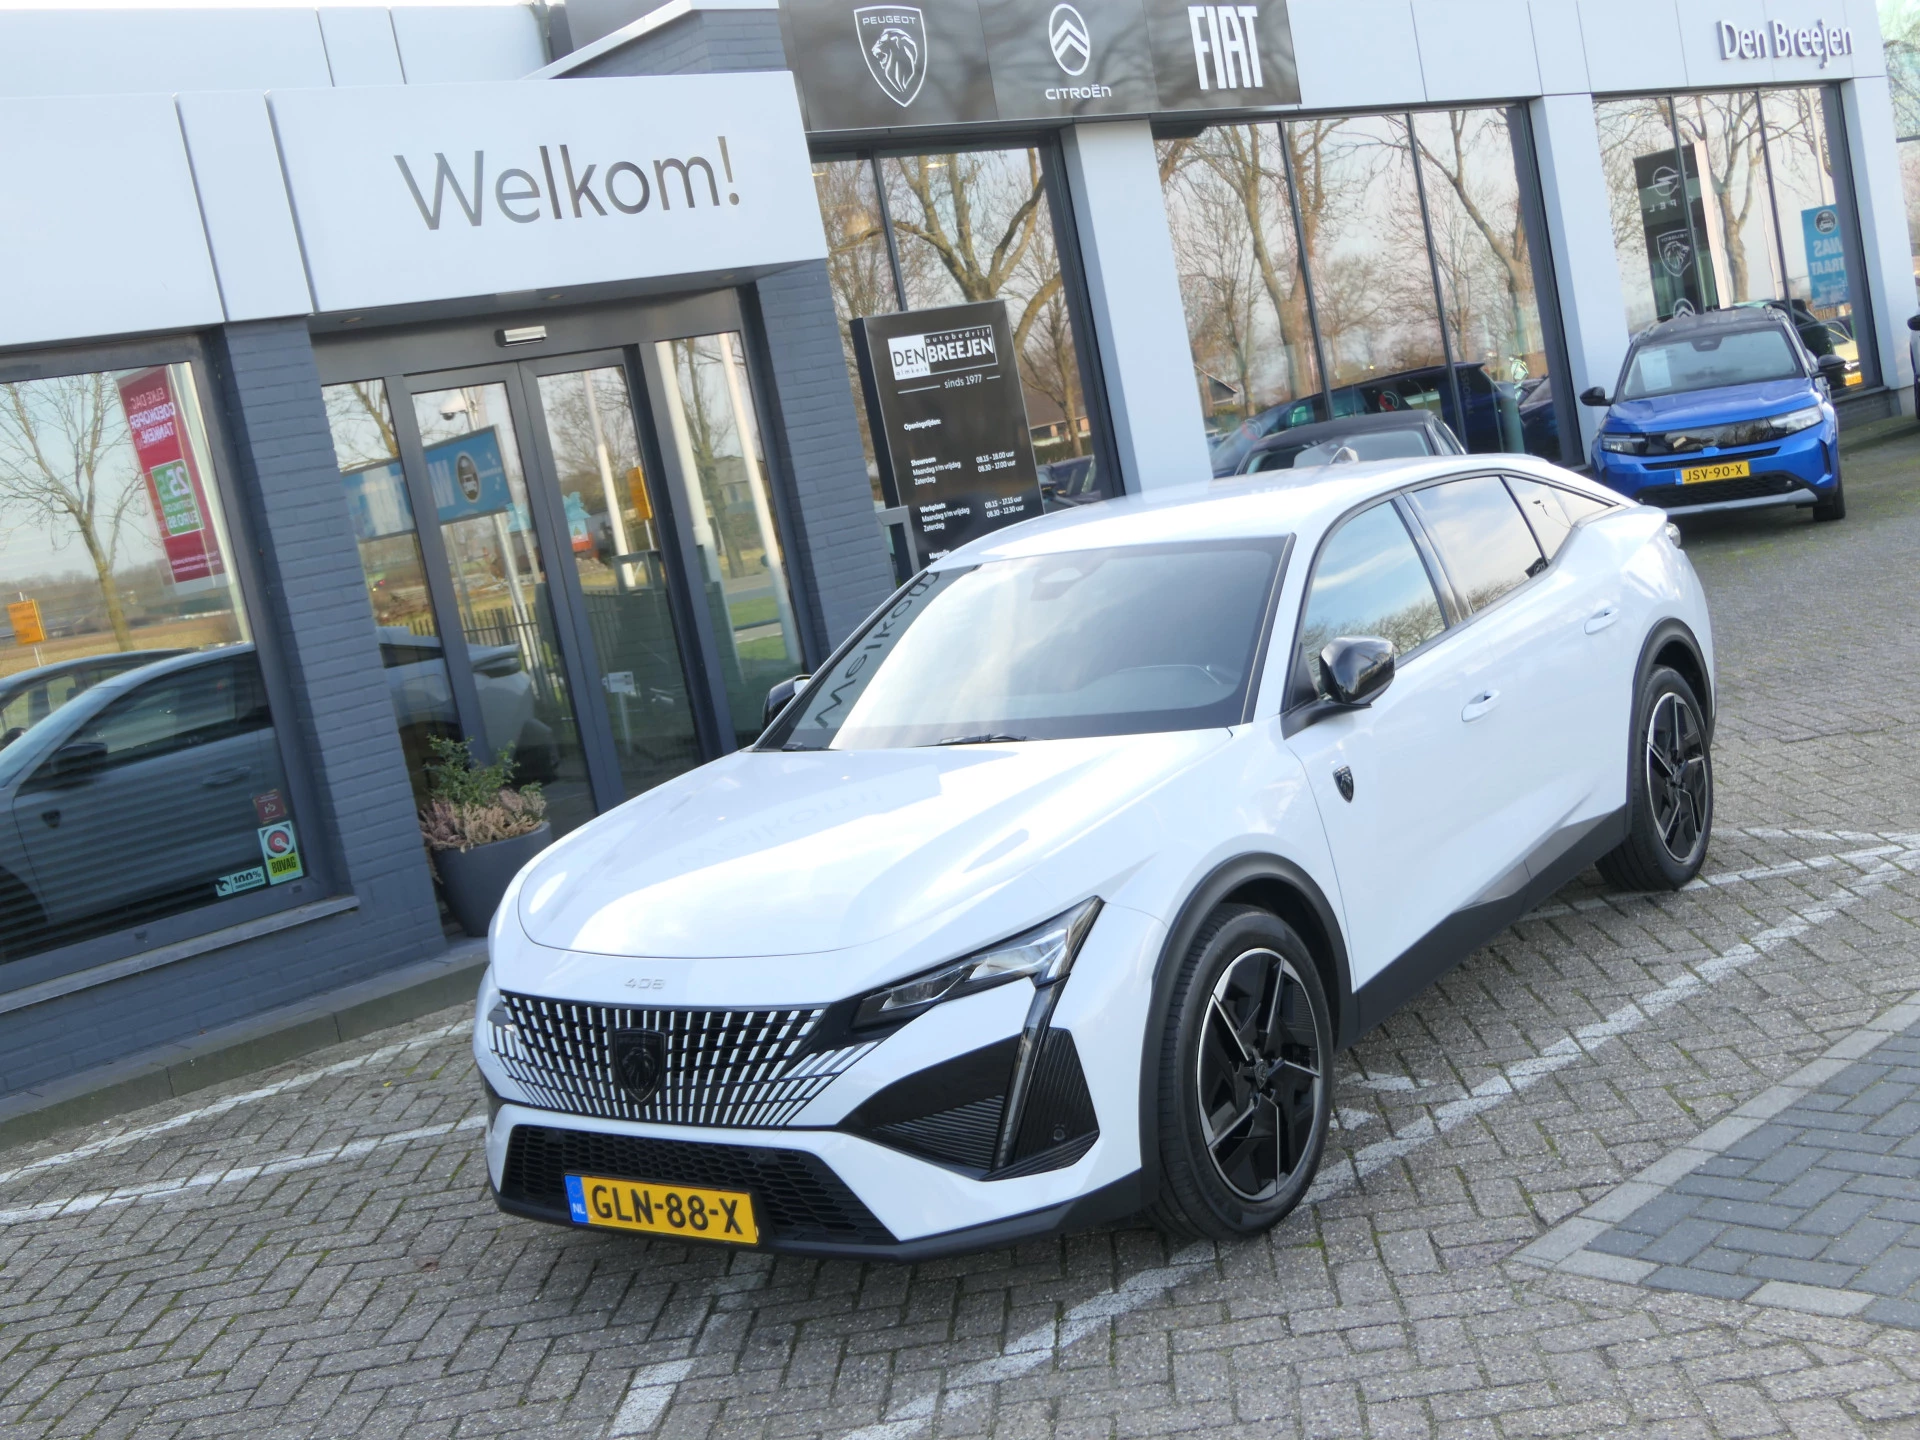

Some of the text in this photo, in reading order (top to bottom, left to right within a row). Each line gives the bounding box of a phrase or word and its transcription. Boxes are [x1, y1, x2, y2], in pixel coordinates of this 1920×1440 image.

[862, 14, 917, 26] PEUGEOT
[1187, 4, 1264, 91] FIAT
[1715, 18, 1853, 69] Den Breejen
[1045, 83, 1112, 101] CITROËN
[394, 135, 741, 231] Welkom!
[925, 328, 990, 344] autobedrijf
[892, 337, 995, 368] DEN BREEJEN
[944, 374, 983, 389] sinds 1977
[910, 456, 937, 467] Showroom
[912, 466, 935, 476] Maandag
[944, 461, 961, 472] vrijdag
[1006, 459, 1016, 467] uur
[1686, 464, 1743, 482] JSV-90-X
[914, 476, 936, 486] Zaterdag
[919, 502, 946, 514] Werkplaats
[921, 512, 944, 523] Maandag
[953, 507, 970, 518] vrijdag
[923, 522, 945, 533] Zaterdag
[271, 856, 297, 874] BOVAG
[233, 869, 262, 884] 100%
[624, 977, 665, 990] 408
[573, 1185, 743, 1235] NL GLN-88-X
